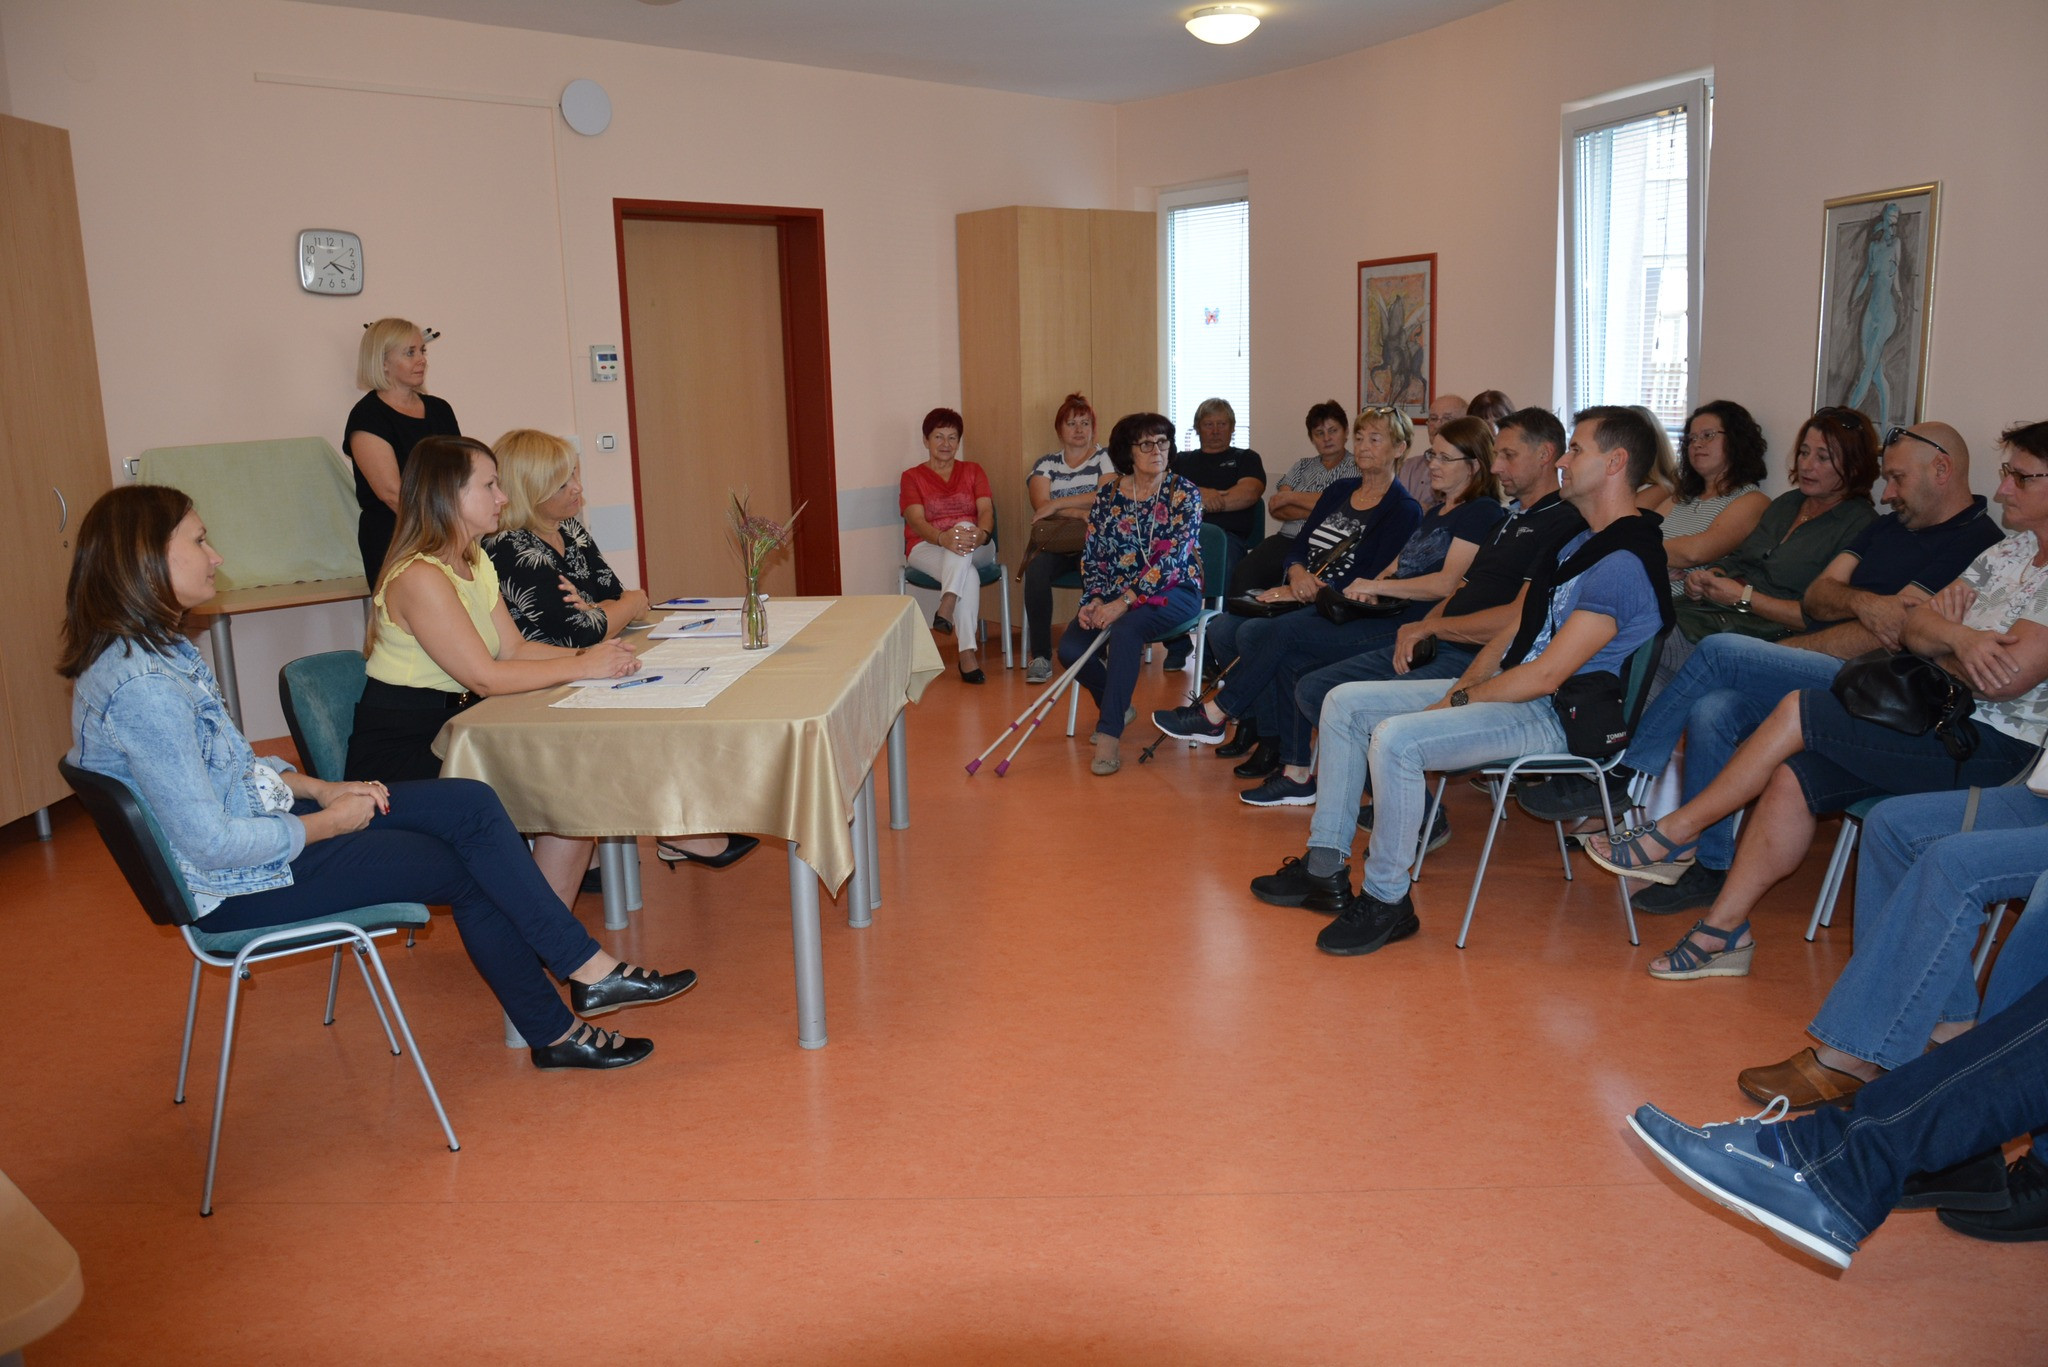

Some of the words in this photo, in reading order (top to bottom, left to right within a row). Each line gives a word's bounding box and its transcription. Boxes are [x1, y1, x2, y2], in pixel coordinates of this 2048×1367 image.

[314, 237, 321, 246] 11
[326, 237, 334, 246] 12
[306, 245, 315, 254] 10
[349, 248, 354, 257] 2
[350, 260, 355, 269] 3
[350, 273, 355, 281] 4
[318, 278, 323, 287] 7
[329, 279, 335, 288] 6
[341, 279, 346, 288] 5
[1606, 731, 1627, 740] TOMMY
